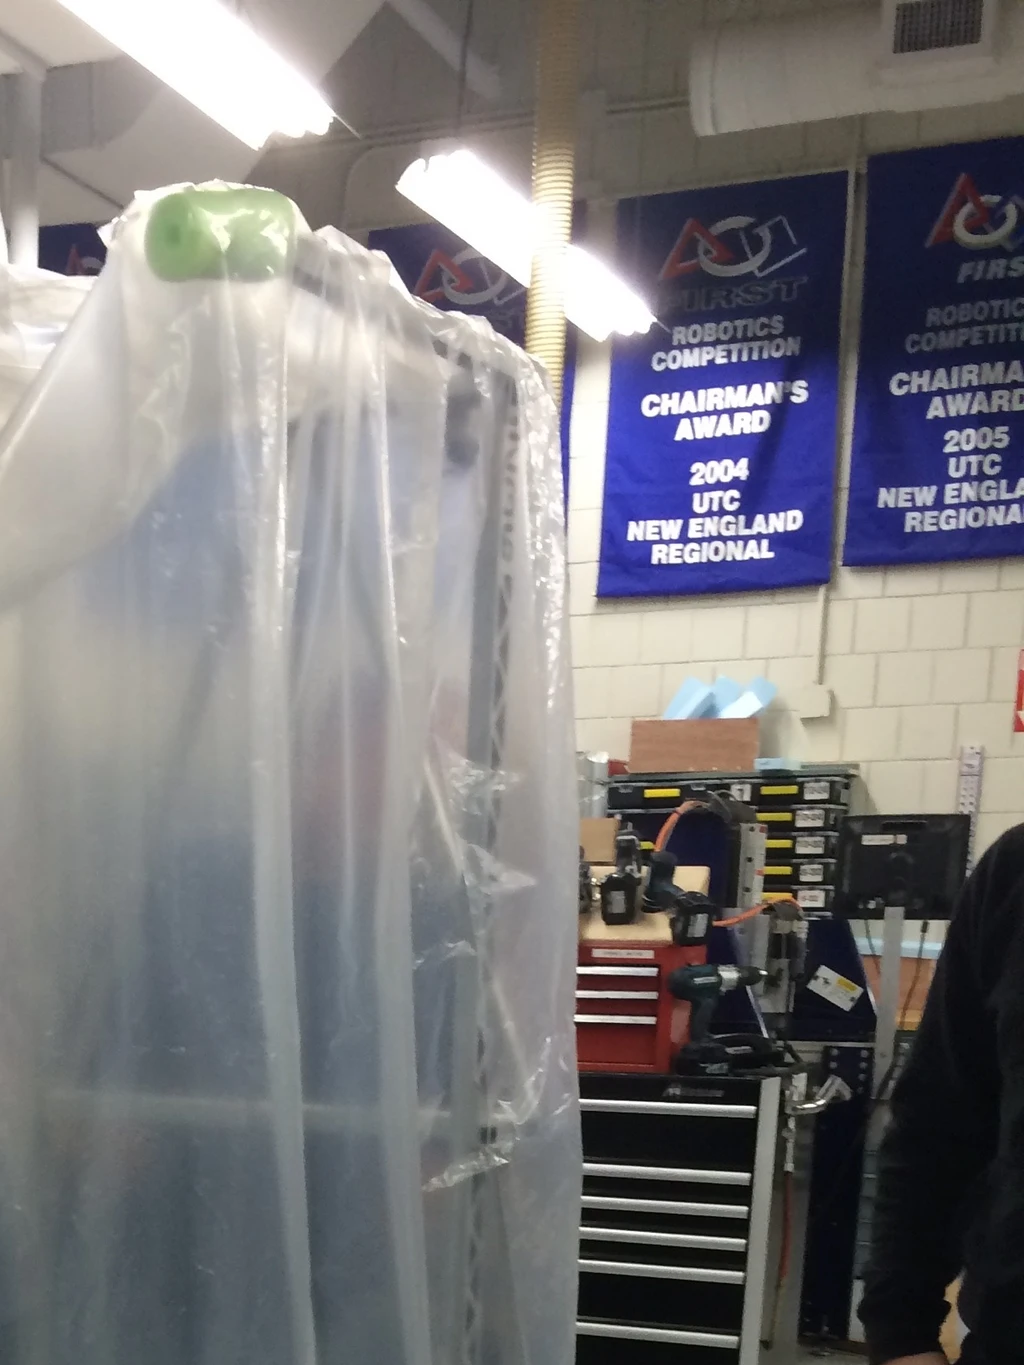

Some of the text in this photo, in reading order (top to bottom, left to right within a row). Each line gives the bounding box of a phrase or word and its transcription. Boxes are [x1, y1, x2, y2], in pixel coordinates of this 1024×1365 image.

[925, 296, 1024, 328] ROBOTIC
[672, 314, 785, 346] ROBOTICS
[650, 336, 802, 372] COMPETITION
[640, 379, 809, 417] CHAIRMAN'S
[673, 409, 772, 441] AWARD
[942, 426, 1011, 453] 2005
[688, 457, 750, 486] 2004
[947, 453, 1003, 479] UTC
[692, 489, 741, 514] UTC
[877, 485, 939, 508] NEW
[626, 509, 804, 542] NEW ENGLAND
[903, 503, 1024, 533] REGIONA
[650, 538, 776, 565] REGIONAL
